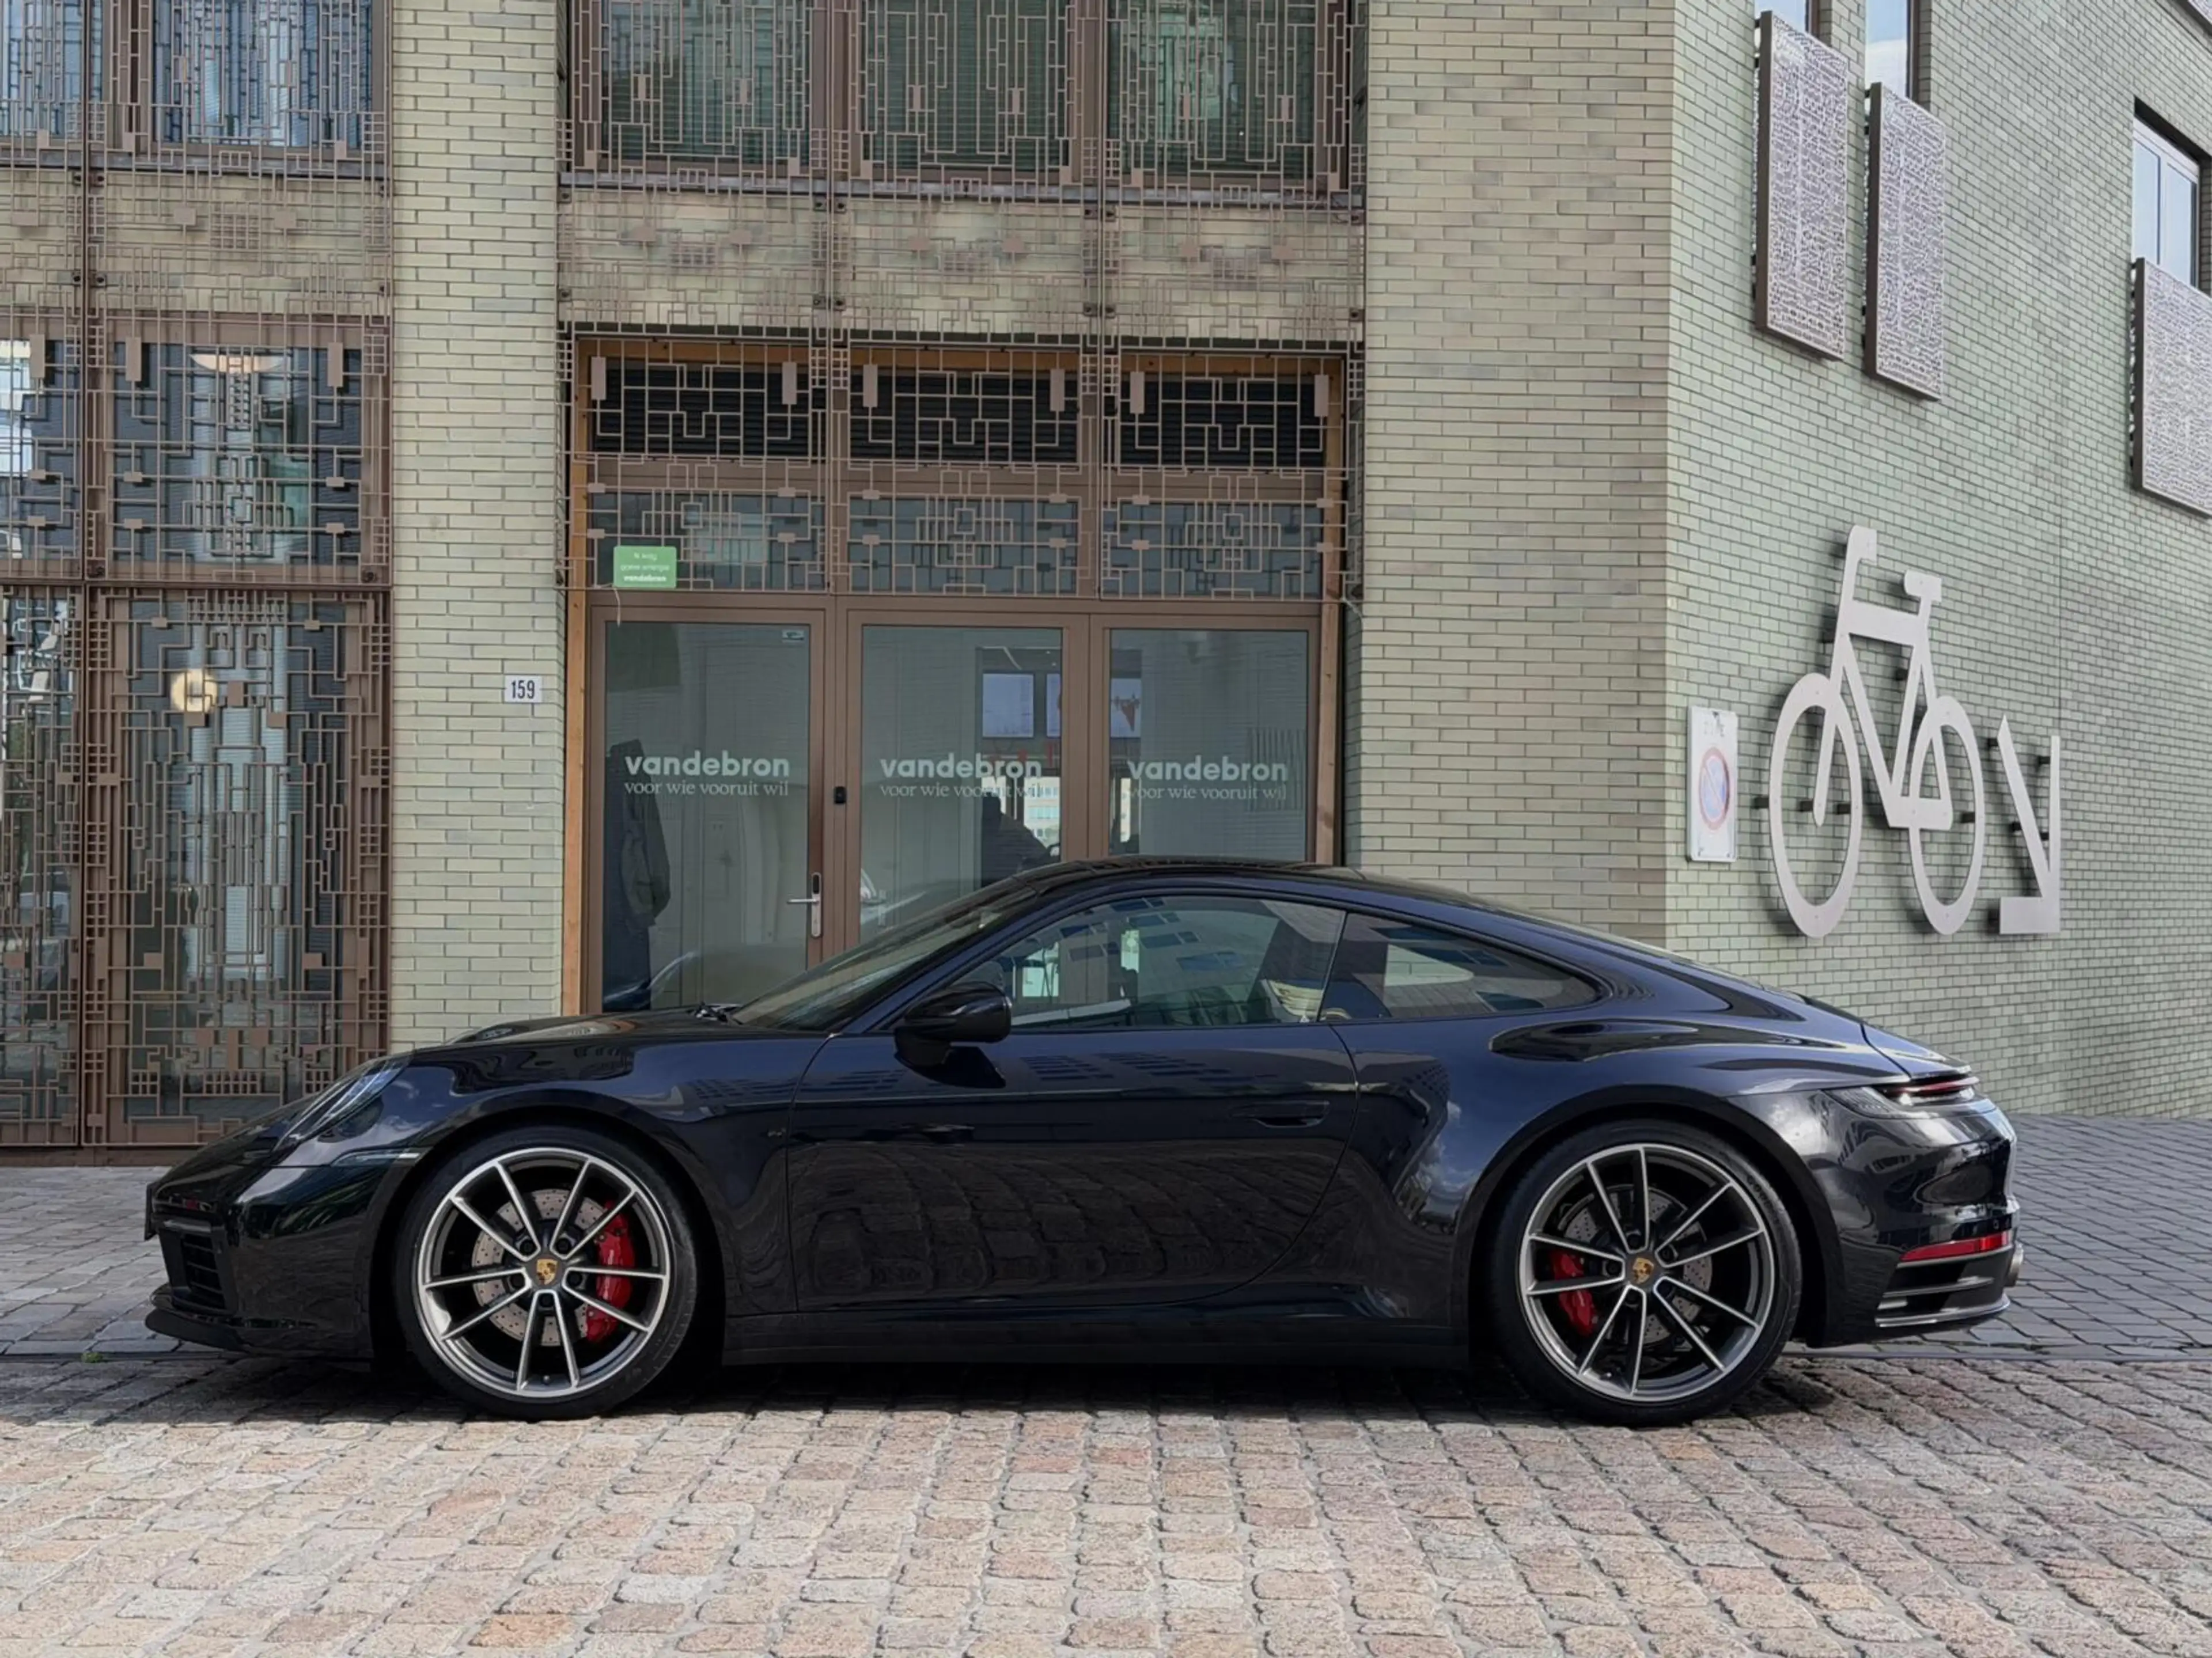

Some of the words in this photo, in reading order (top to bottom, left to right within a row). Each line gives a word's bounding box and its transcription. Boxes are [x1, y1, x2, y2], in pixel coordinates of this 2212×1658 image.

[512, 680, 535, 699] 159
[624, 750, 789, 776] vandebron
[880, 753, 1042, 779] vandebron
[1127, 754, 1287, 781] vandebron
[624, 781, 662, 795] voor
[666, 779, 695, 795] wie
[699, 780, 759, 795] vooruit
[763, 780, 789, 796] wil
[880, 784, 916, 797] voor
[921, 781, 950, 798] wie
[1168, 784, 1197, 799] wie
[1200, 784, 1258, 799] vooruit
[1262, 784, 1287, 800] wil
